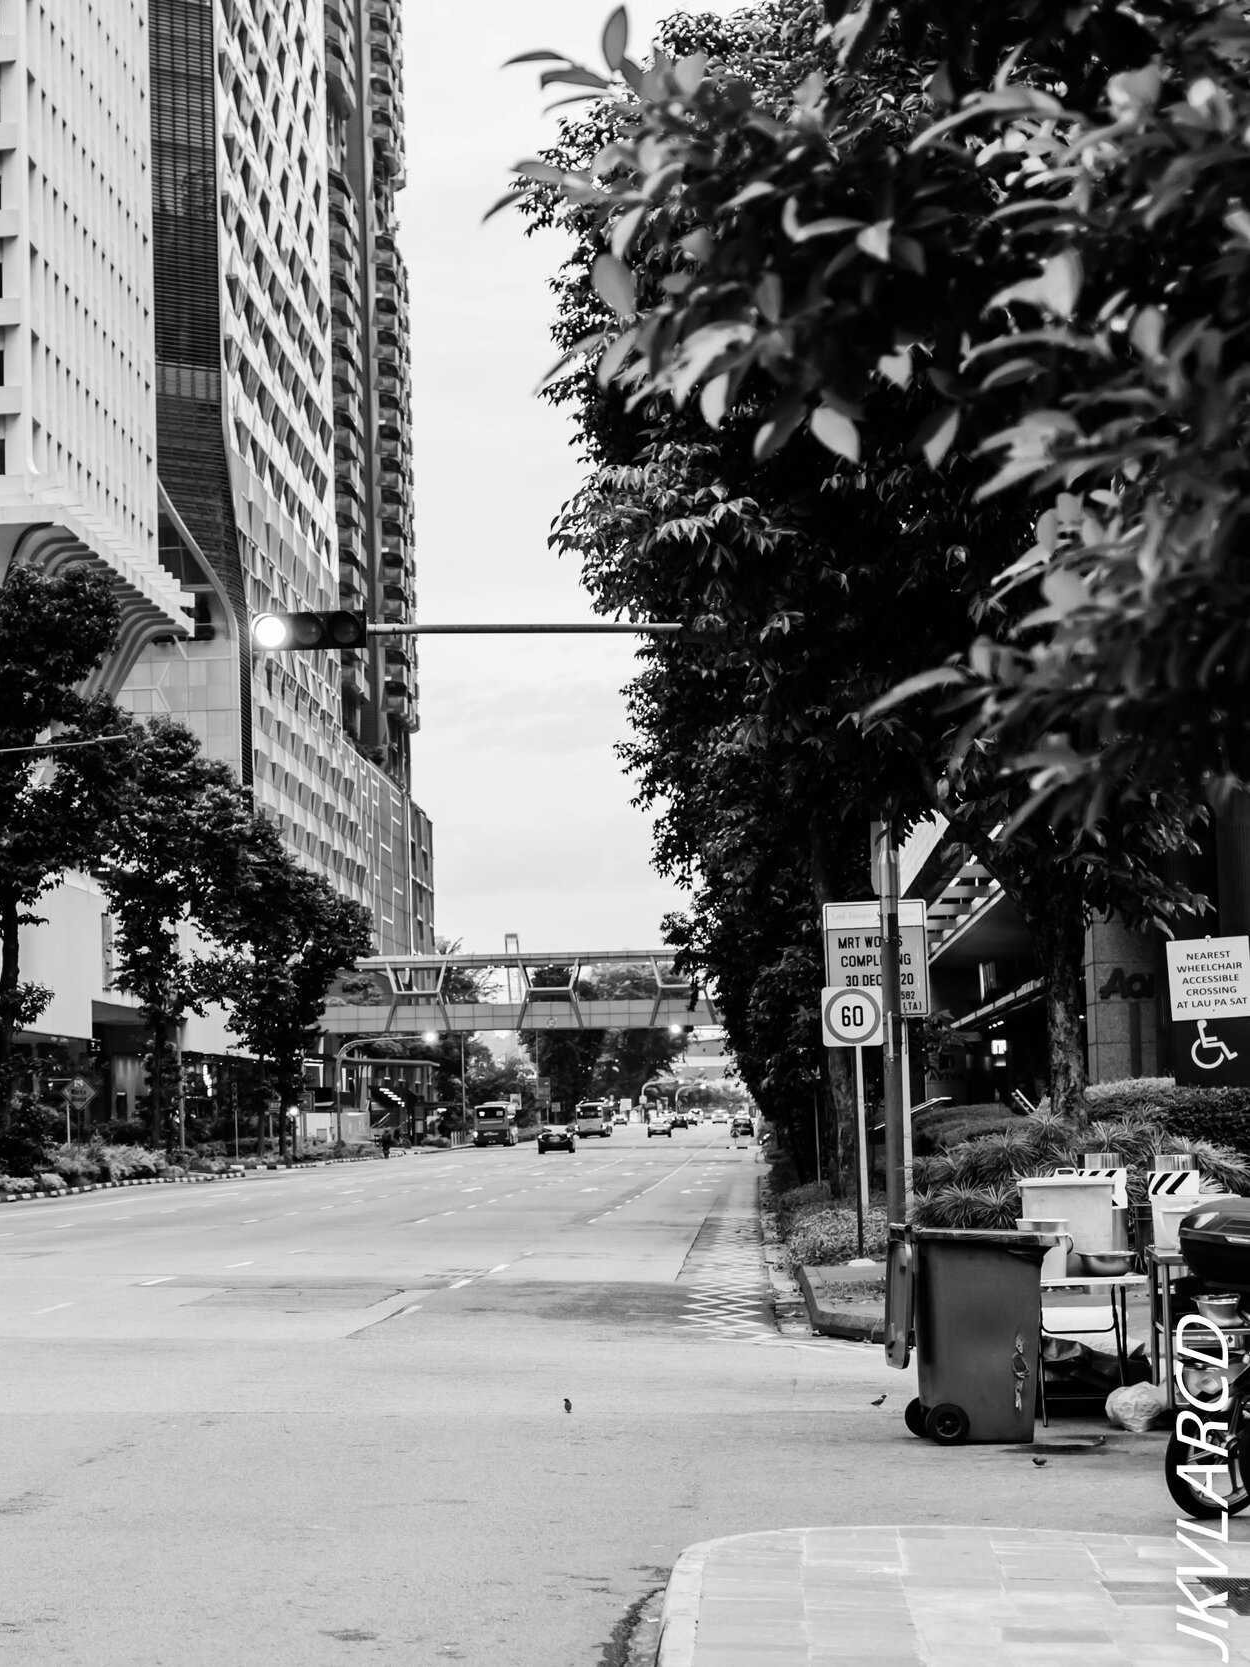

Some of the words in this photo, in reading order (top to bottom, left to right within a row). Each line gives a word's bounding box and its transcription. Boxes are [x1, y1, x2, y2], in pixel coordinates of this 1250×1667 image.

[838, 936, 860, 949] MRT
[864, 935, 903, 948] WOS
[841, 953, 911, 968] COMPLG
[1186, 950, 1231, 960] NEAREST
[1176, 961, 1243, 973] WHEELCHAIR
[845, 975, 859, 987] 30
[862, 974, 882, 986] DEC
[1182, 973, 1240, 985] ACCESSIBLE
[1186, 985, 1237, 996] CROSSING
[1176, 1001, 1188, 1009] AT
[1191, 999, 1211, 1008] LAU
[1214, 998, 1228, 1006] PA
[1229, 997, 1248, 1006] SAT
[841, 1005, 864, 1027] 60
